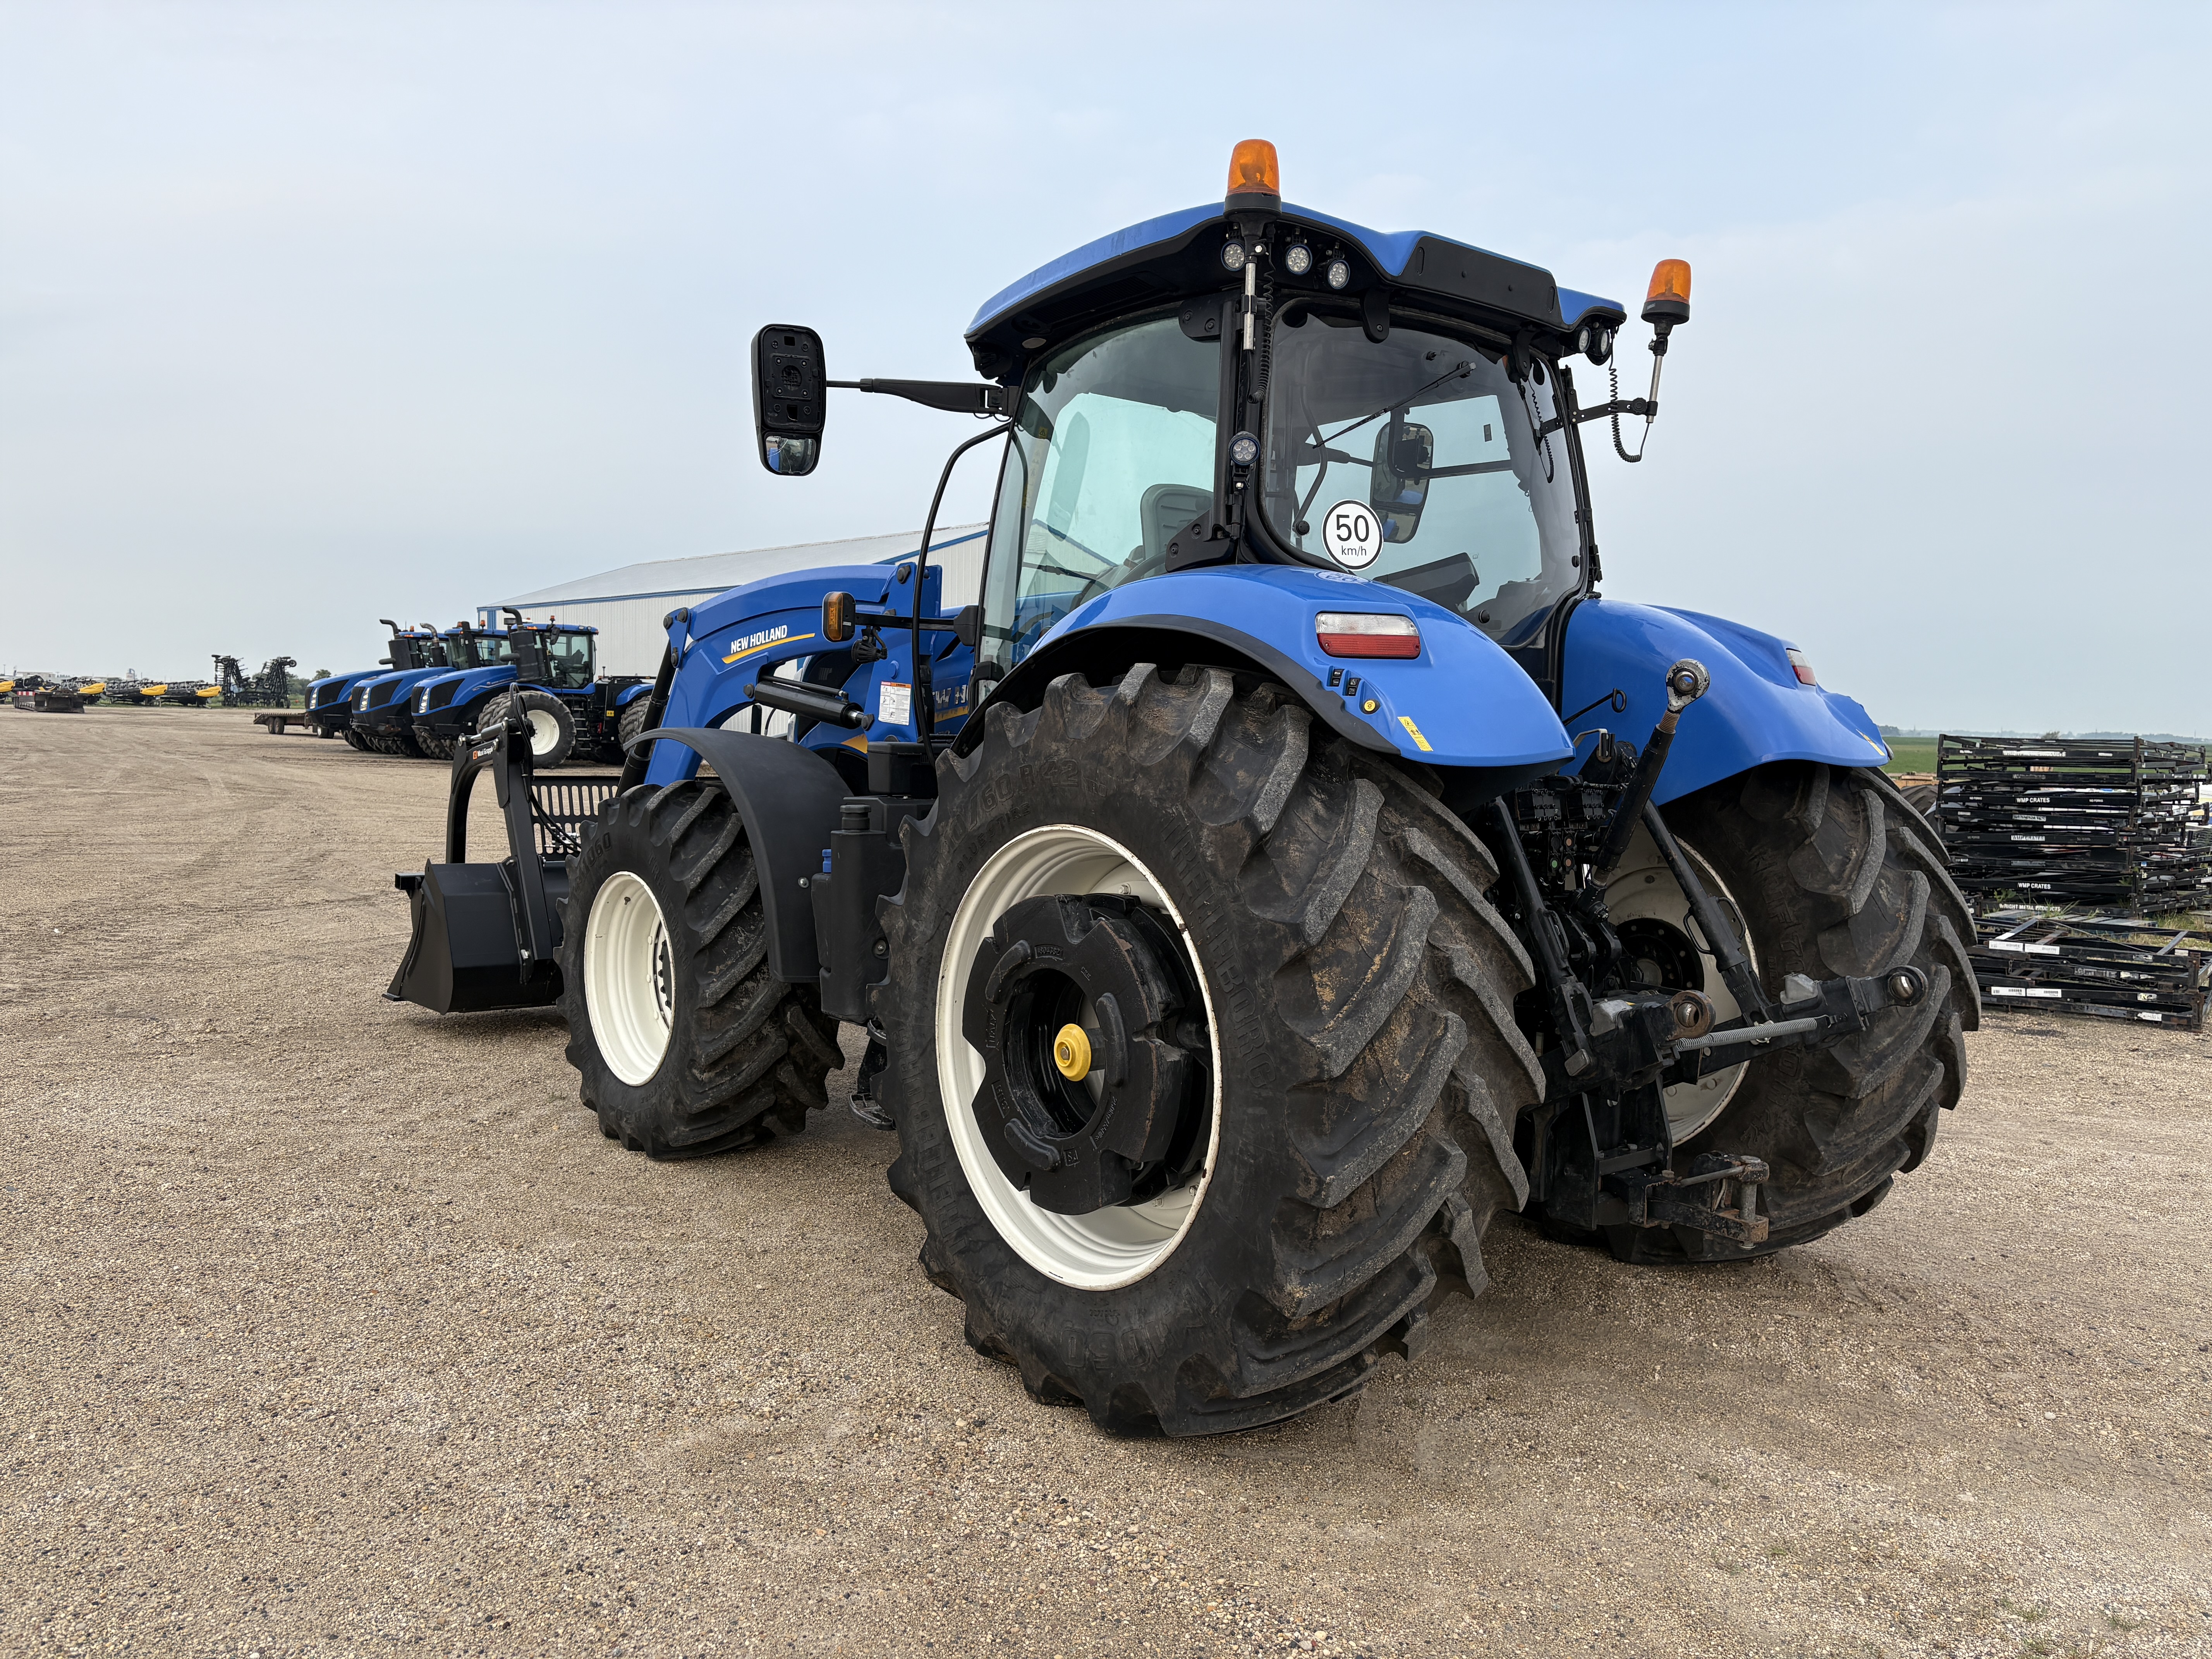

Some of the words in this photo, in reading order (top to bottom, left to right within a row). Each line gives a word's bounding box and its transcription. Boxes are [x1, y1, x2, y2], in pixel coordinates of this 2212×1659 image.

[1336, 514, 1369, 542] 50
[1341, 545, 1366, 556] km/h
[731, 636, 749, 654] NEW
[750, 625, 787, 647] HOLLAND
[1160, 803, 1276, 1089] TRELLEBORG
